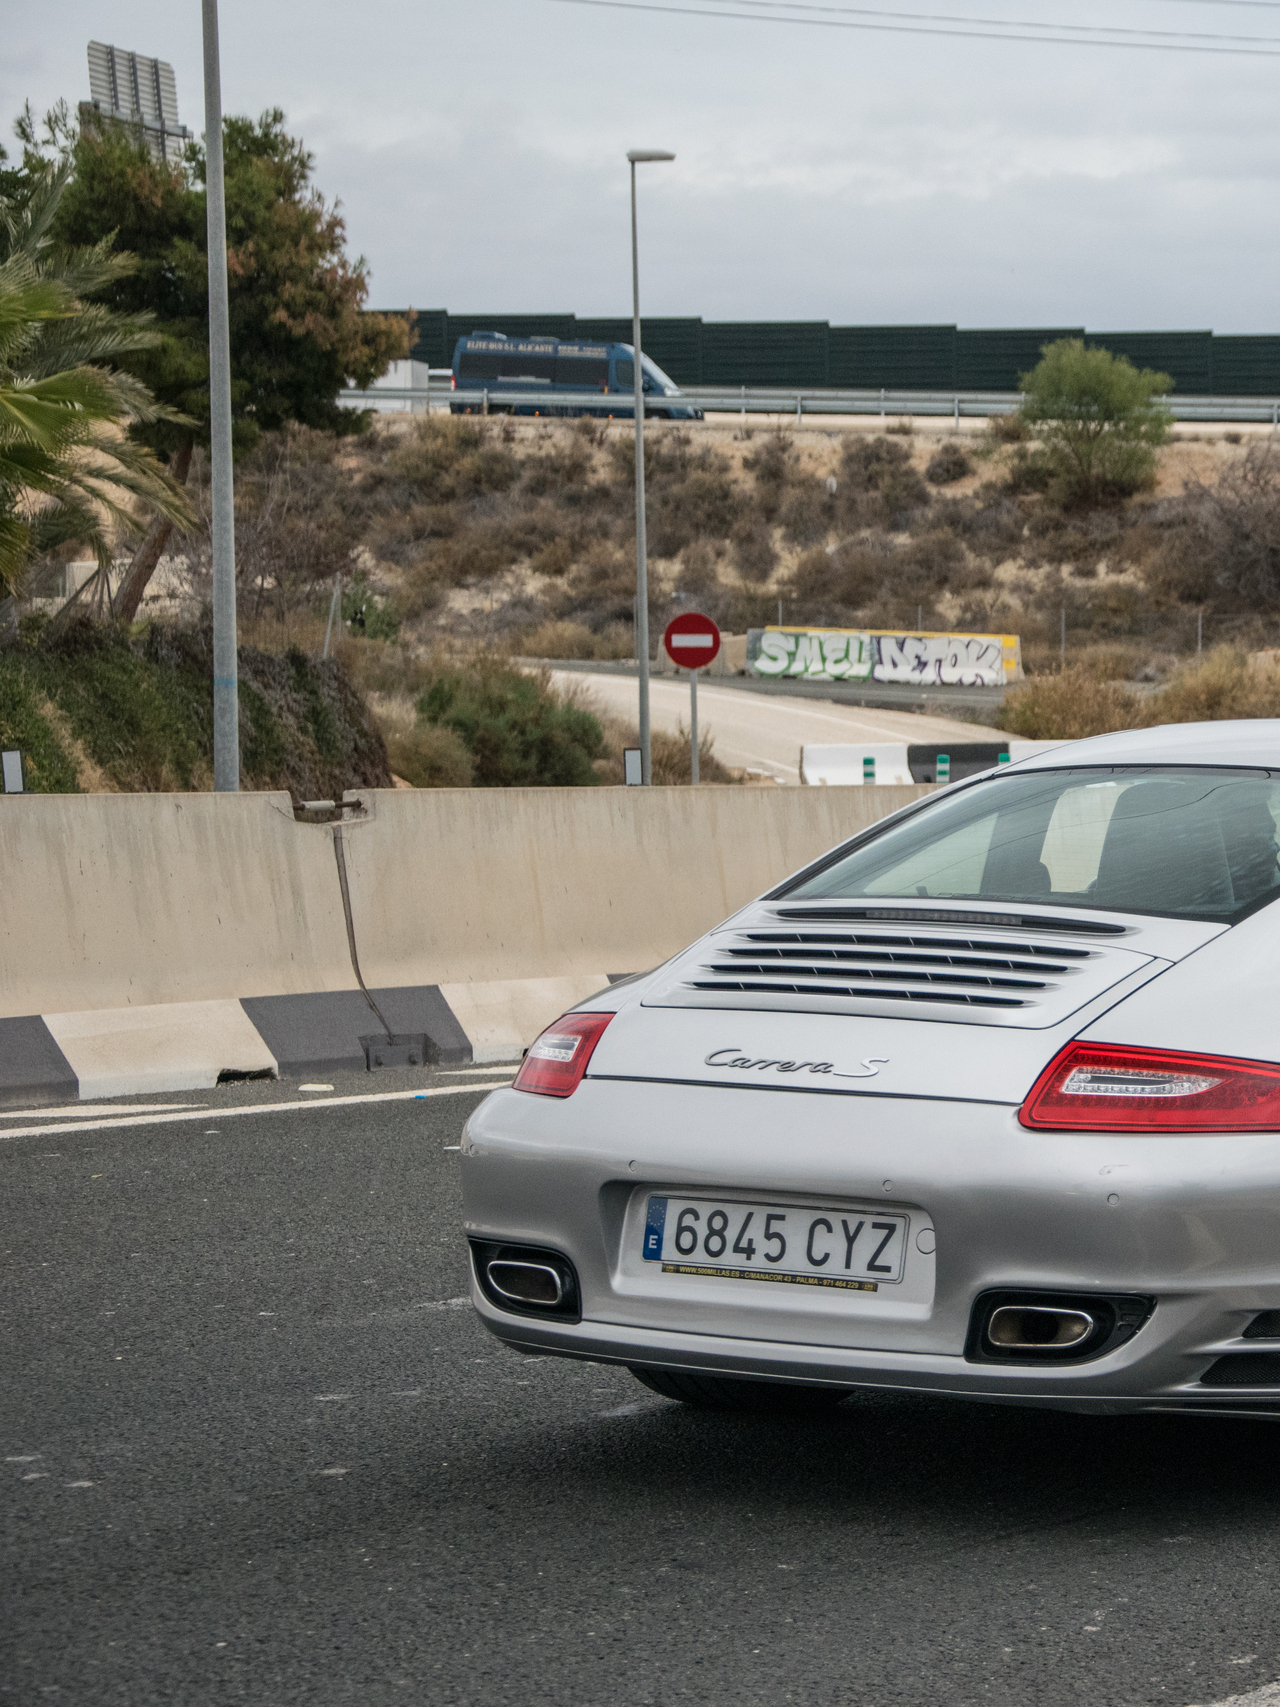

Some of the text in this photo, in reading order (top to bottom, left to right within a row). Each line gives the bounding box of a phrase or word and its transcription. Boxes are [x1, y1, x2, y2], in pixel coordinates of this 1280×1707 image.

[704, 1048, 890, 1078] Carrera S
[649, 1234, 658, 1249] E
[674, 1207, 897, 1273] 6845 CYZ
[680, 1266, 740, 1278] WWW.500MILLAS.ES
[784, 1275, 792, 1283] 43
[796, 1276, 818, 1285] PALMA
[823, 1279, 834, 1287] 971
[835, 1280, 846, 1288] 464
[847, 1281, 859, 1289] 229
